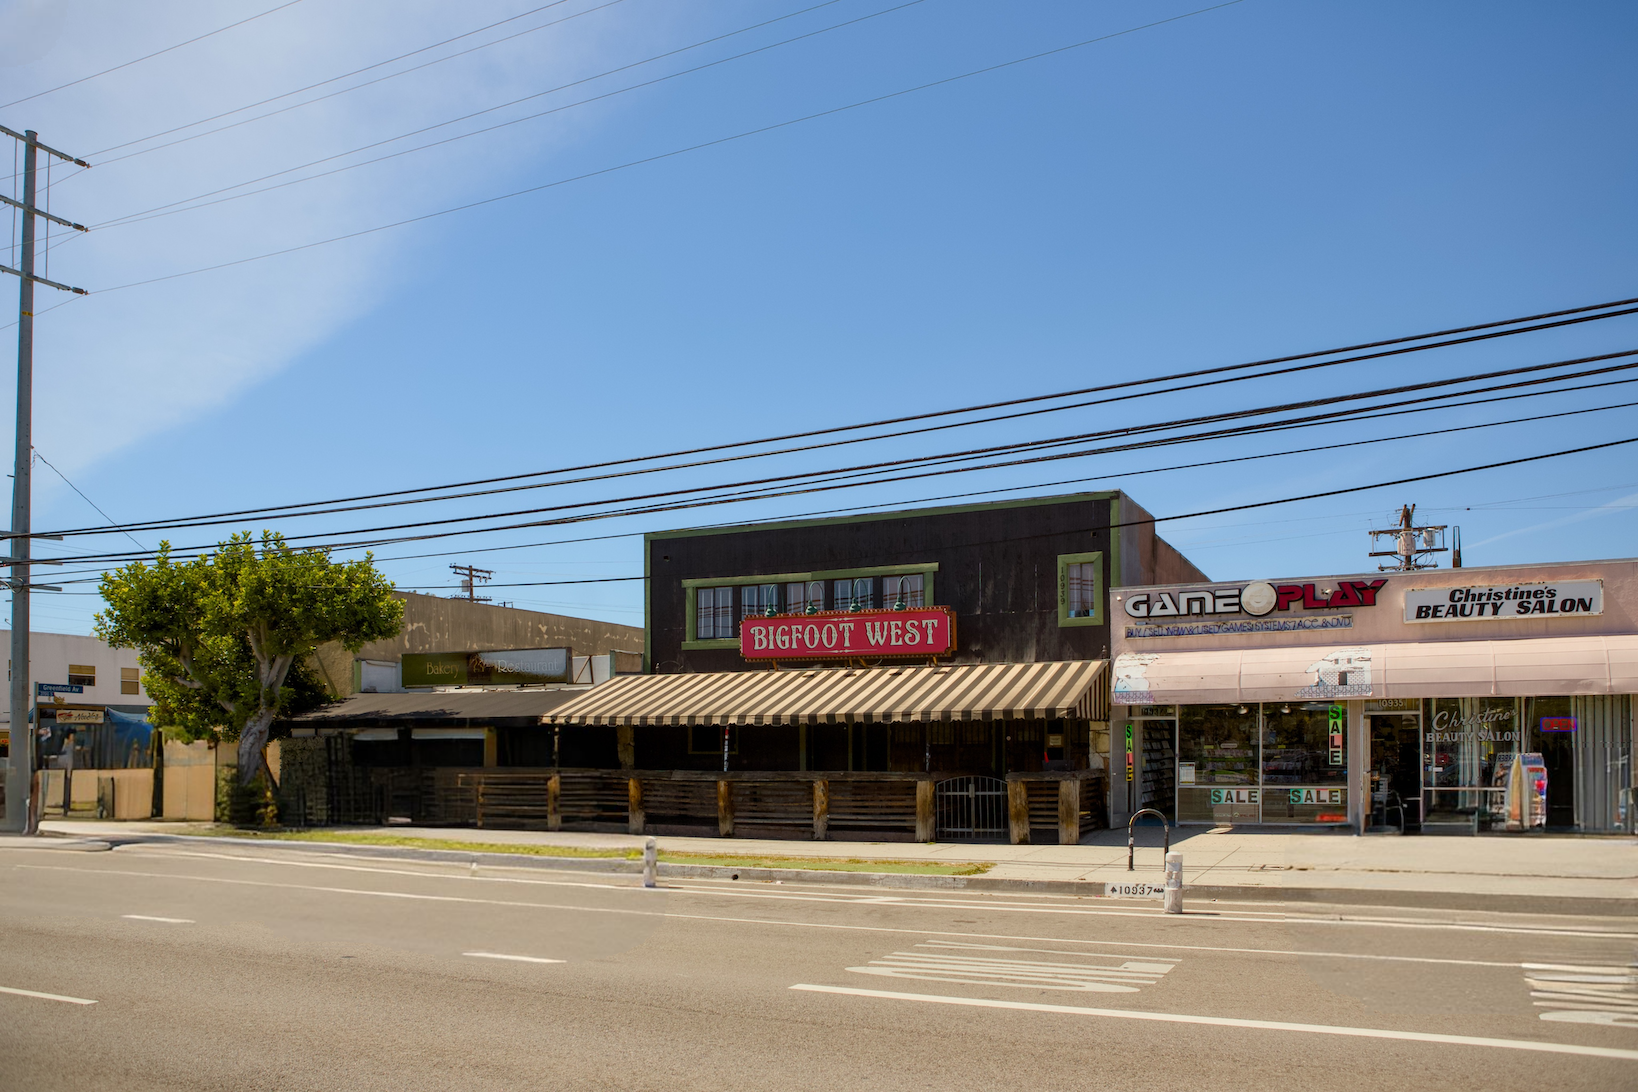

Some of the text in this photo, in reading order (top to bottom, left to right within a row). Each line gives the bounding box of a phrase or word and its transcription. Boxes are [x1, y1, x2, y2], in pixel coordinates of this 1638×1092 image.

[1124, 578, 1388, 618] GAME PLAY
[1448, 585, 1557, 603] Christine's
[1415, 597, 1593, 619] BEAUTY SALON
[749, 619, 938, 651] BIGFOOT WEST
[425, 661, 460, 679] Bakery
[497, 658, 560, 673] Restaurant
[1378, 699, 1404, 708] 10935
[1431, 708, 1518, 732] Christine's
[1541, 719, 1577, 731] OPEN
[1329, 705, 1342, 765] SALE
[1425, 731, 1521, 743] BEAUTY SALON
[1211, 789, 1259, 804] SALE
[1290, 789, 1341, 804] SALE
[1119, 885, 1153, 895] 10937
